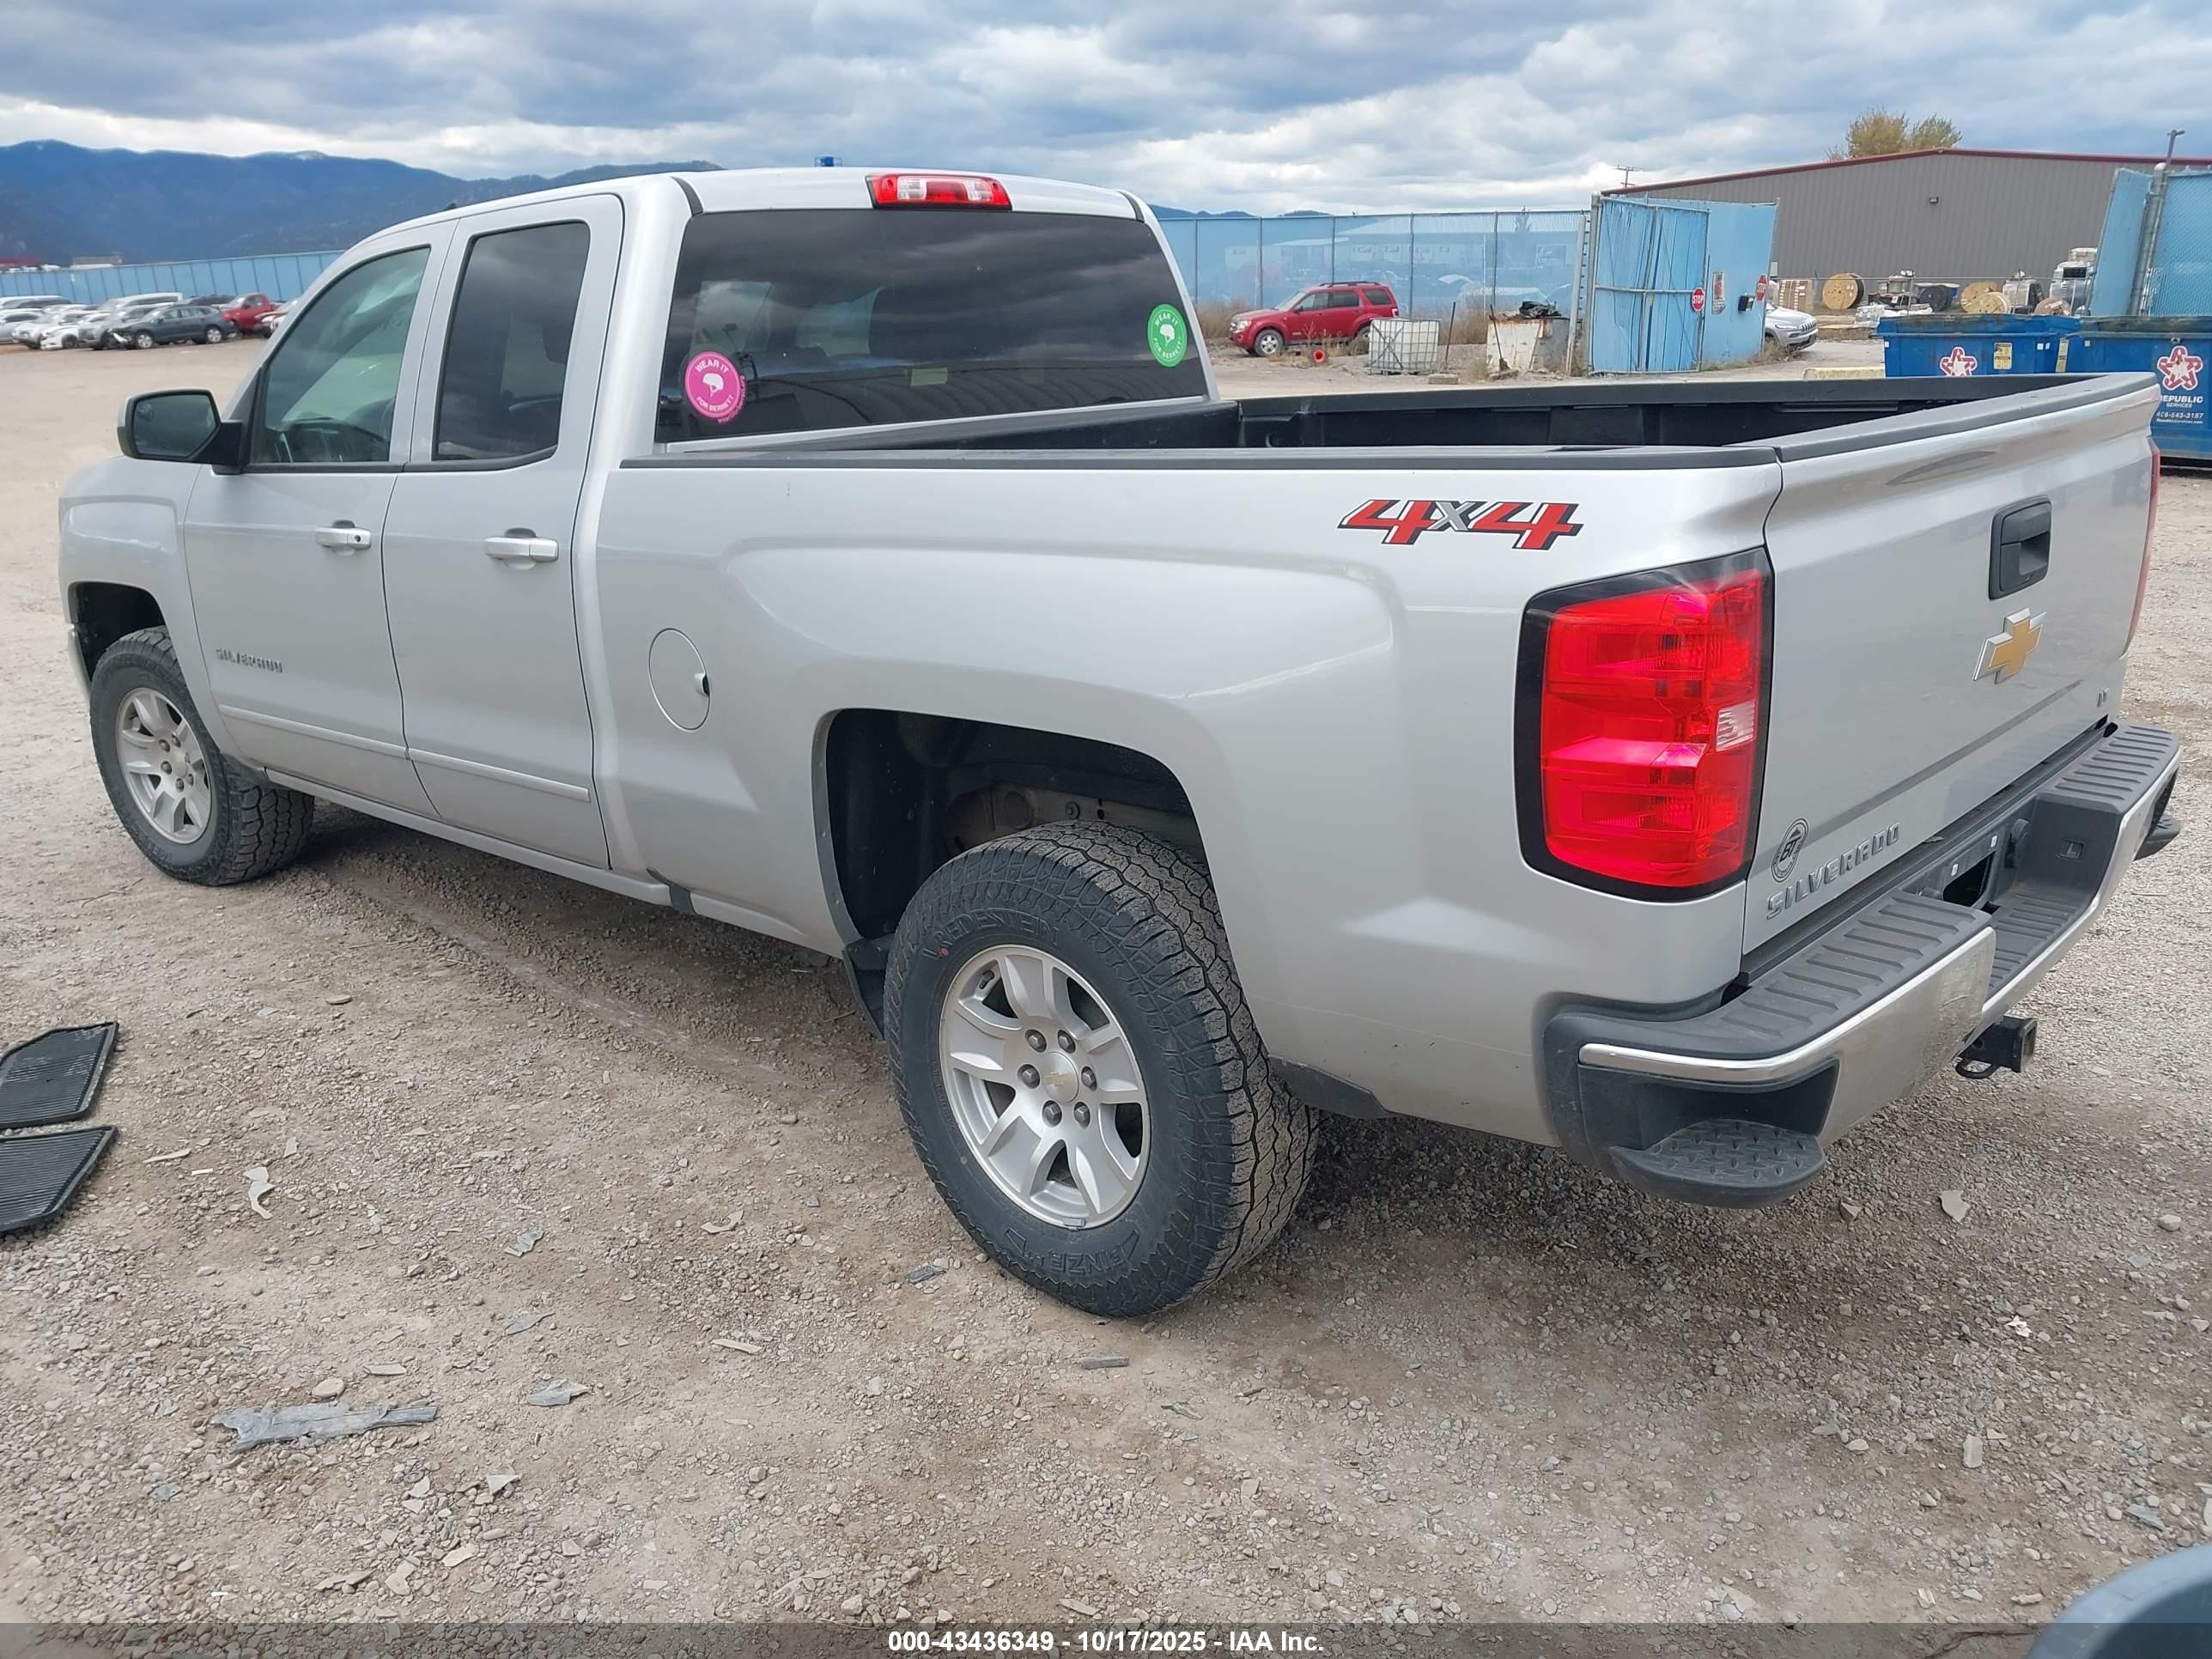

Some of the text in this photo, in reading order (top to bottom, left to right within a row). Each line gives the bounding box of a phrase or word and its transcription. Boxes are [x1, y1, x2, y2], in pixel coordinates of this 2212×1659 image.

[1154, 313, 1178, 326] WEAR IT
[694, 359, 729, 374] WEAR IT
[696, 396, 708, 410] FOR
[2162, 395, 2204, 404] EPUBLIC
[1766, 821, 1900, 921] SILVERADO
